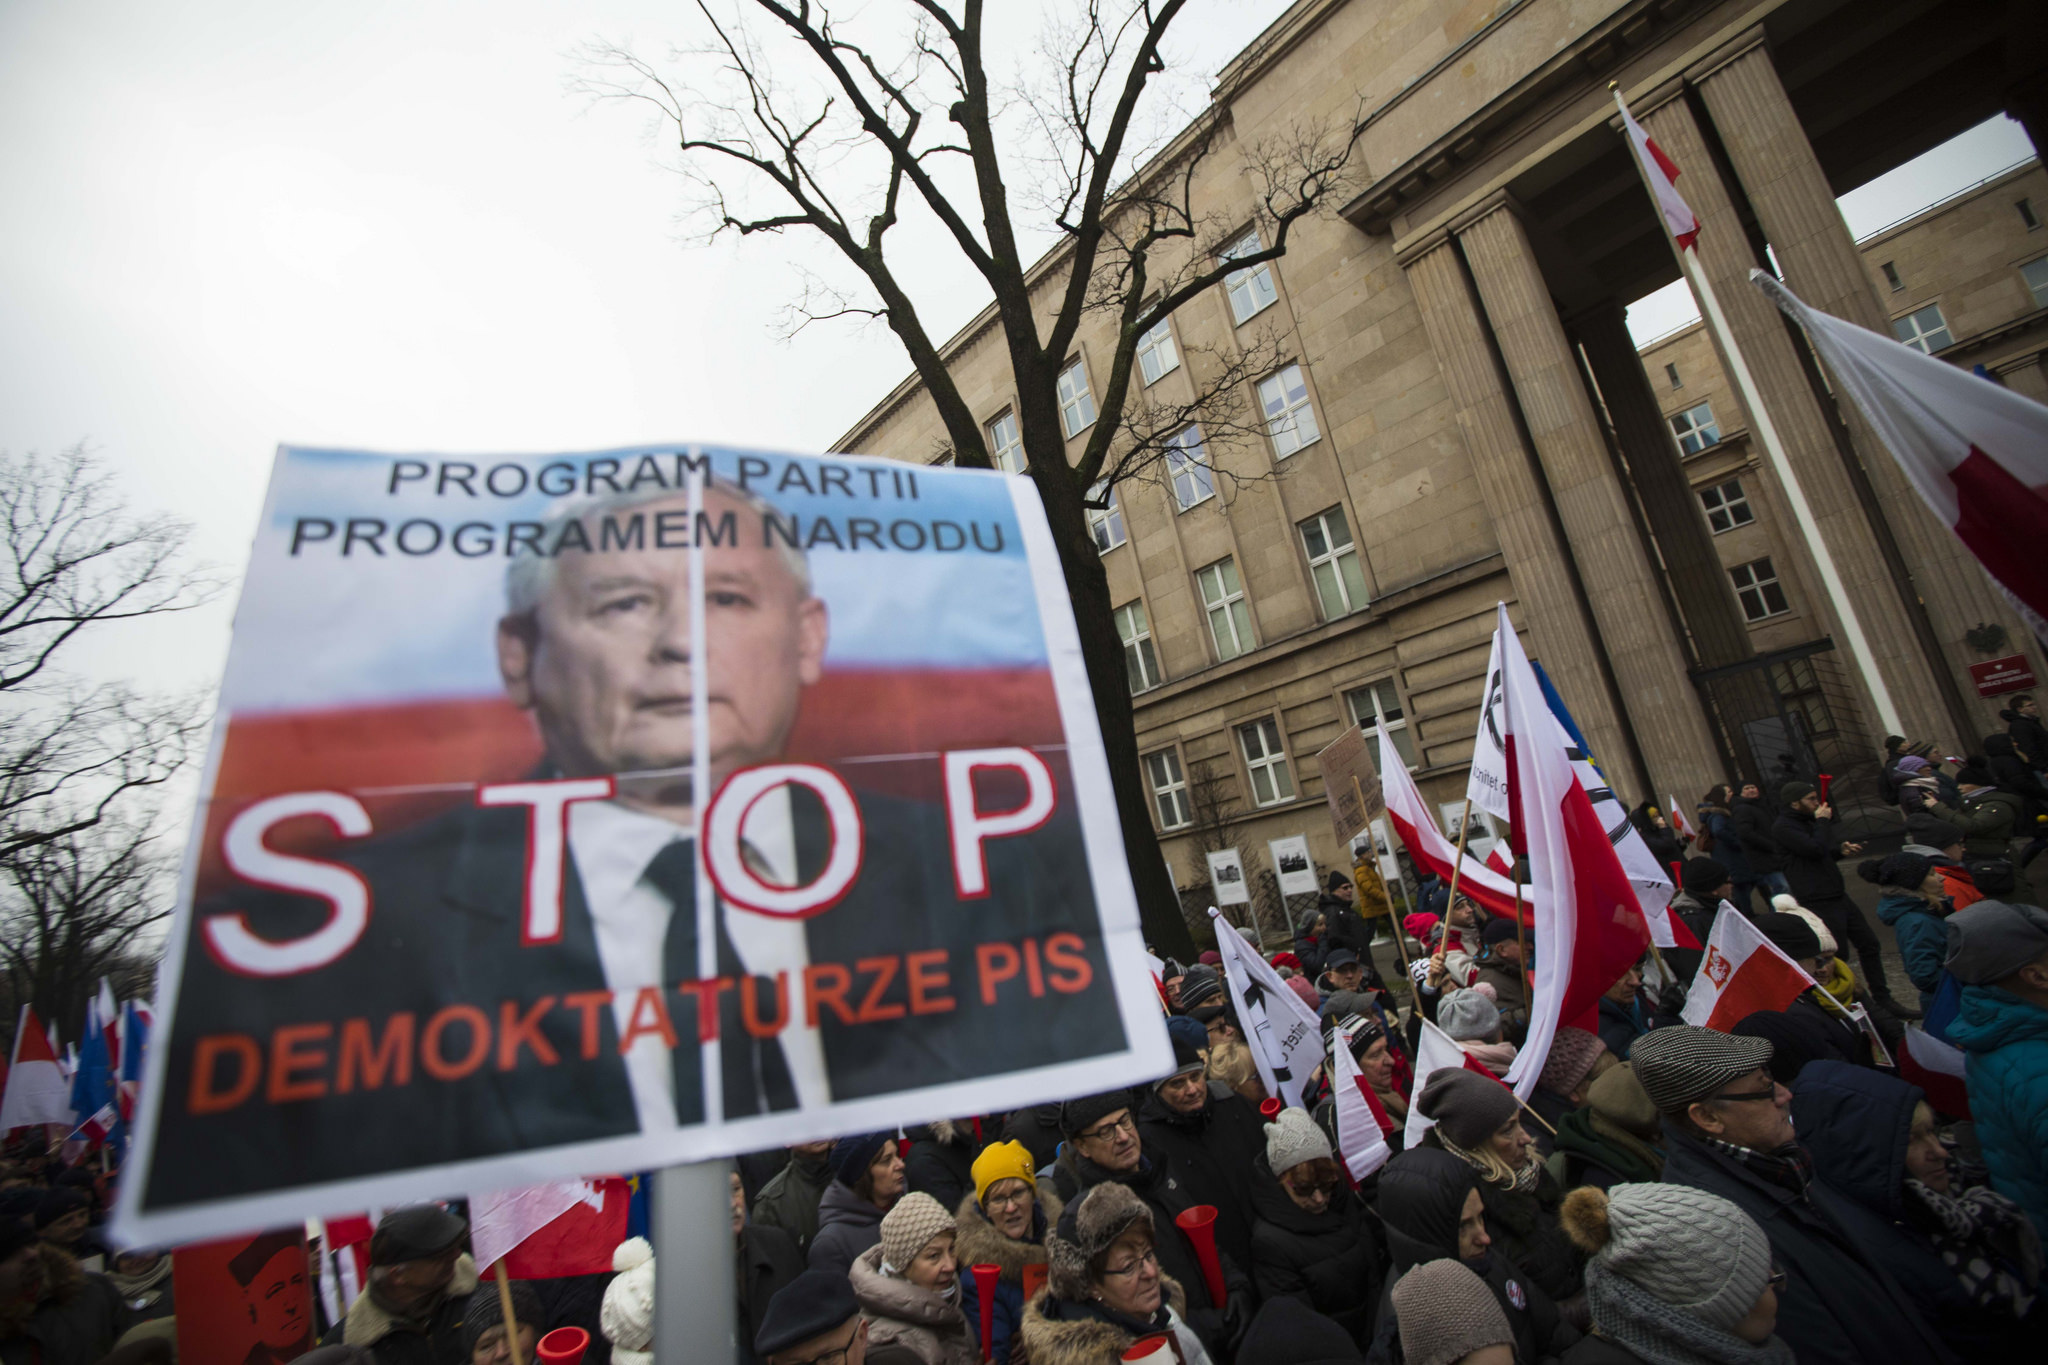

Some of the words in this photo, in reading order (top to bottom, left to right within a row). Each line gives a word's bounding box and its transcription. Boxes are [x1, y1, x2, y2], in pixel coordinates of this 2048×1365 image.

[388, 452, 713, 498] PROGRAM
[737, 455, 920, 500] PARTII
[290, 510, 737, 558] PROGRAMEM
[762, 513, 1006, 554] NARODU
[202, 746, 1057, 978] STOP
[187, 948, 956, 1115] DEMOKTATURZE
[976, 932, 1093, 1005] PIS
